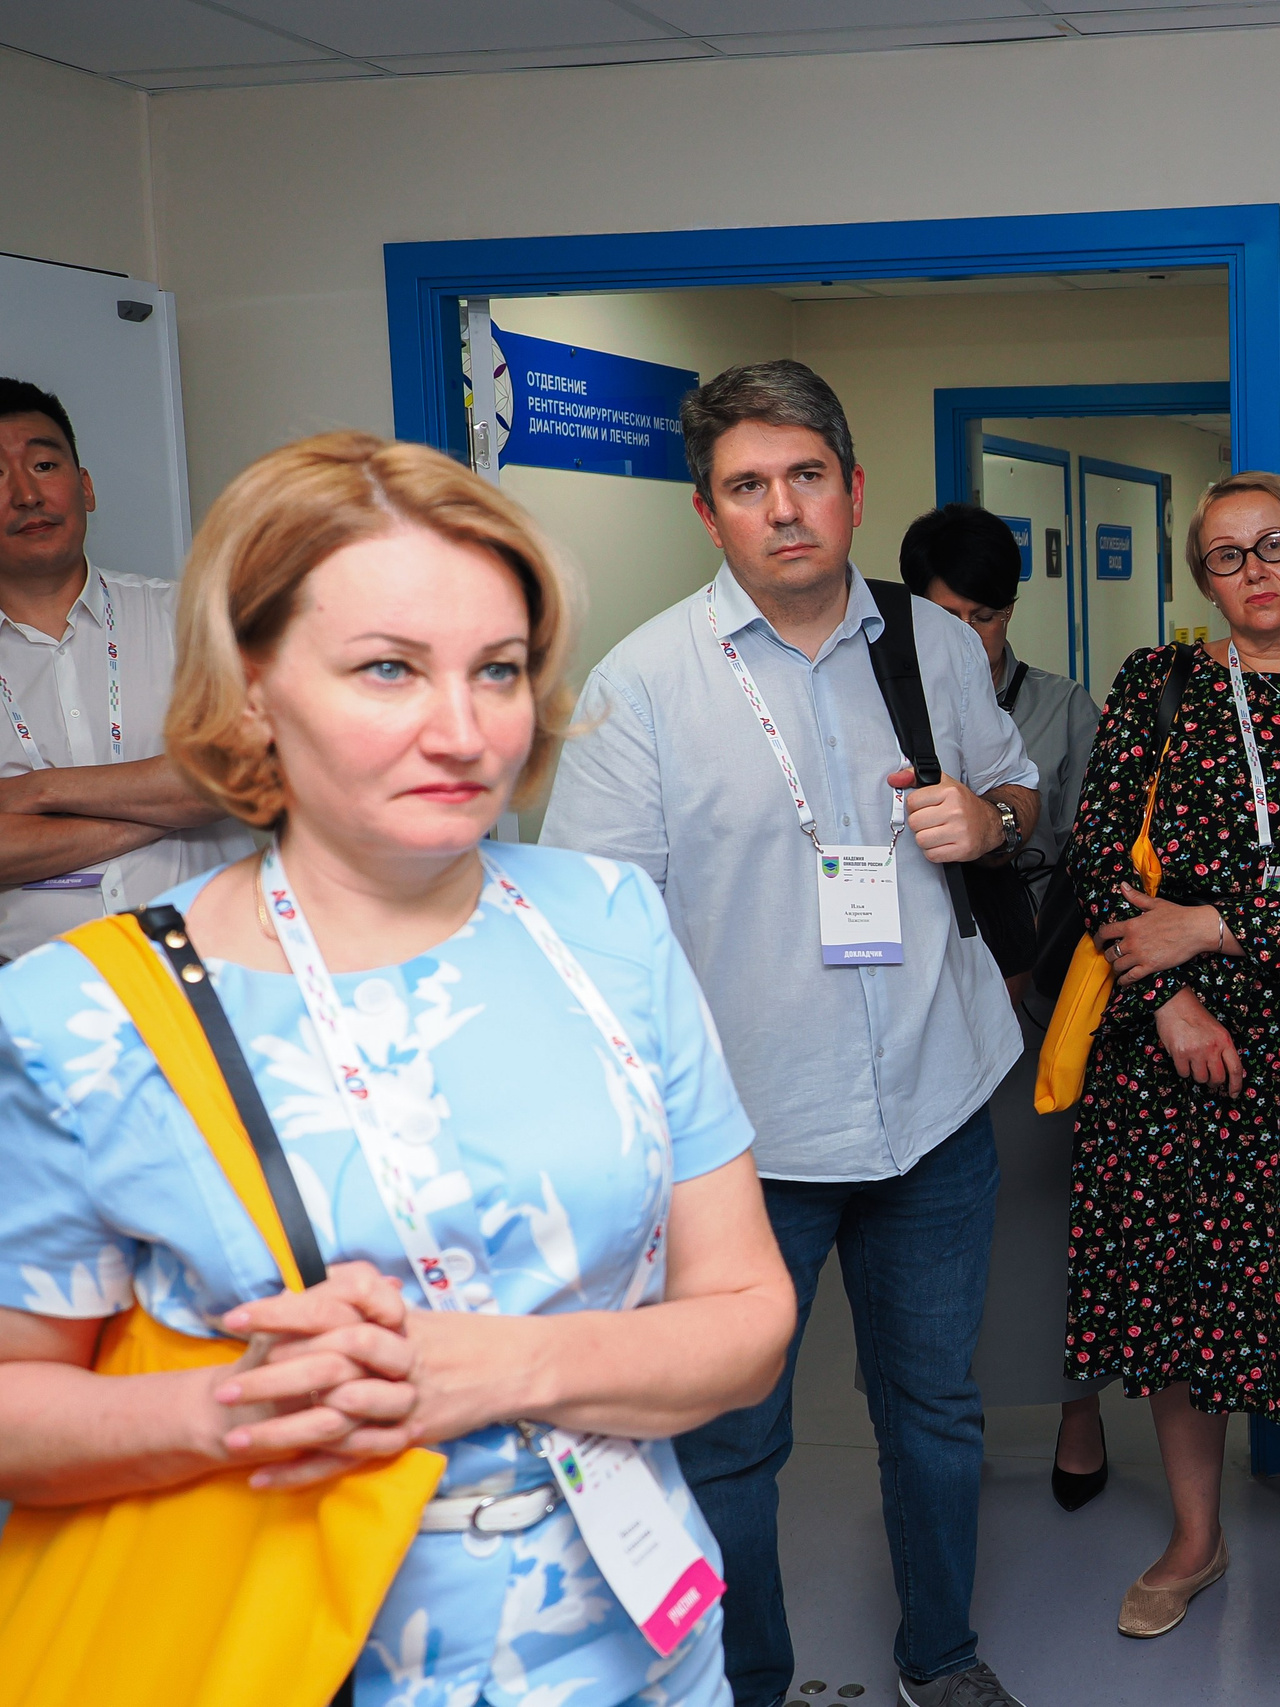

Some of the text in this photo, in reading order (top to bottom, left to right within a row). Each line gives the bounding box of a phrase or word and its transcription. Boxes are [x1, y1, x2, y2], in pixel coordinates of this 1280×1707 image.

[527, 370, 587, 396] ОТДЕЛЕНИЕ
[527, 396, 651, 429] РЕНТГЕНОХИРУРГИЧЕСКИХ
[529, 418, 650, 447] ДИАГНОСТИКИ И ЛЕЧЕНИЯ
[844, 950, 883, 959] ДОКЛАДЧИК
